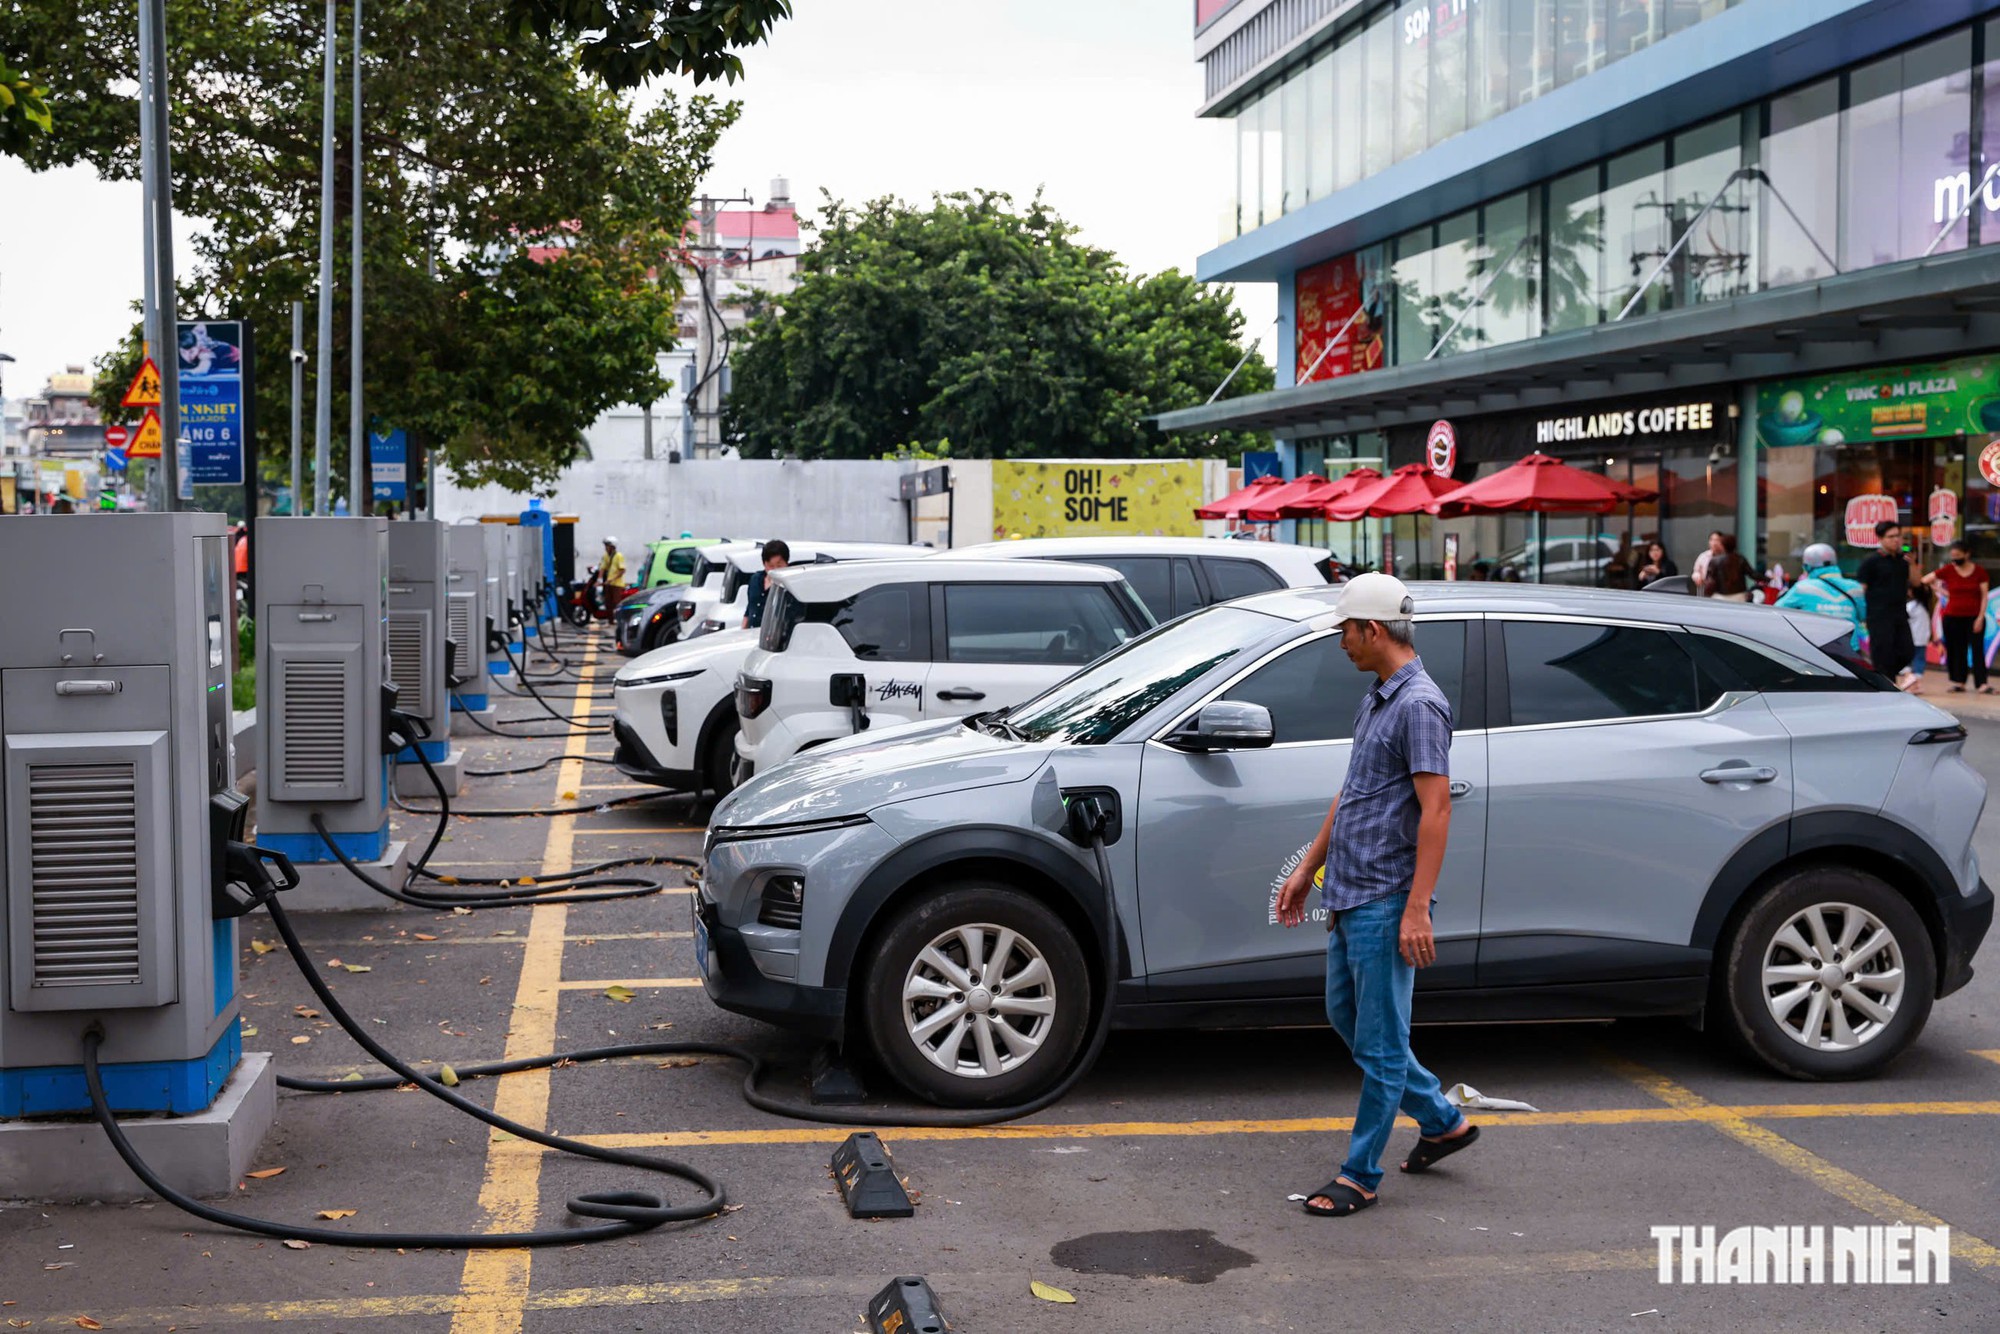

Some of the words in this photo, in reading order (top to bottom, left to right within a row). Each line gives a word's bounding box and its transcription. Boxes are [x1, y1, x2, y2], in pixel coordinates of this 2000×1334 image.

[1908, 378, 1957, 396] PLAZA
[182, 424, 215, 441] ÁNG
[221, 427, 230, 441] 6
[1536, 411, 1635, 443] HIGHLANDS
[1638, 403, 1712, 433] COFFEE
[1064, 469, 1102, 494] OH!
[1064, 497, 1128, 522] SOME
[1280, 856, 1300, 877] GIÁO
[1312, 908, 1329, 922] 02
